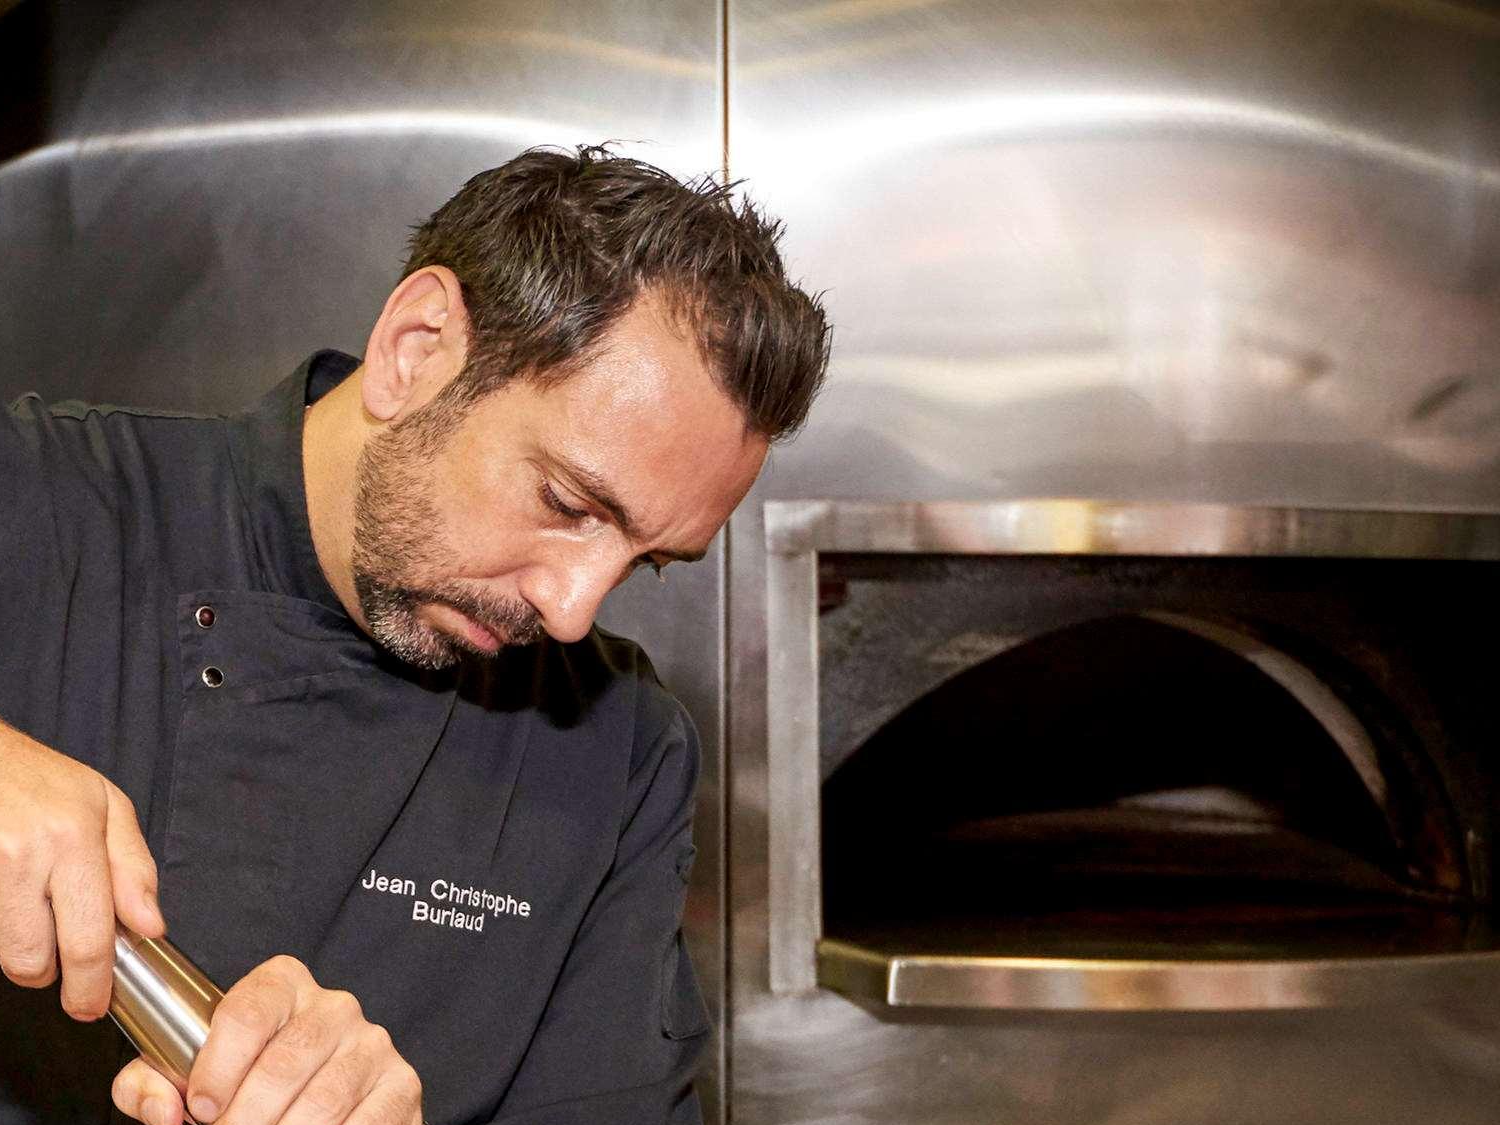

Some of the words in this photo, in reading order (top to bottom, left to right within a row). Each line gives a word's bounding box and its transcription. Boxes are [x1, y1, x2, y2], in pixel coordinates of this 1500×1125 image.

[362, 869, 416, 896] Jean
[430, 879, 532, 917] Christophe
[412, 900, 485, 932] Burlaud
